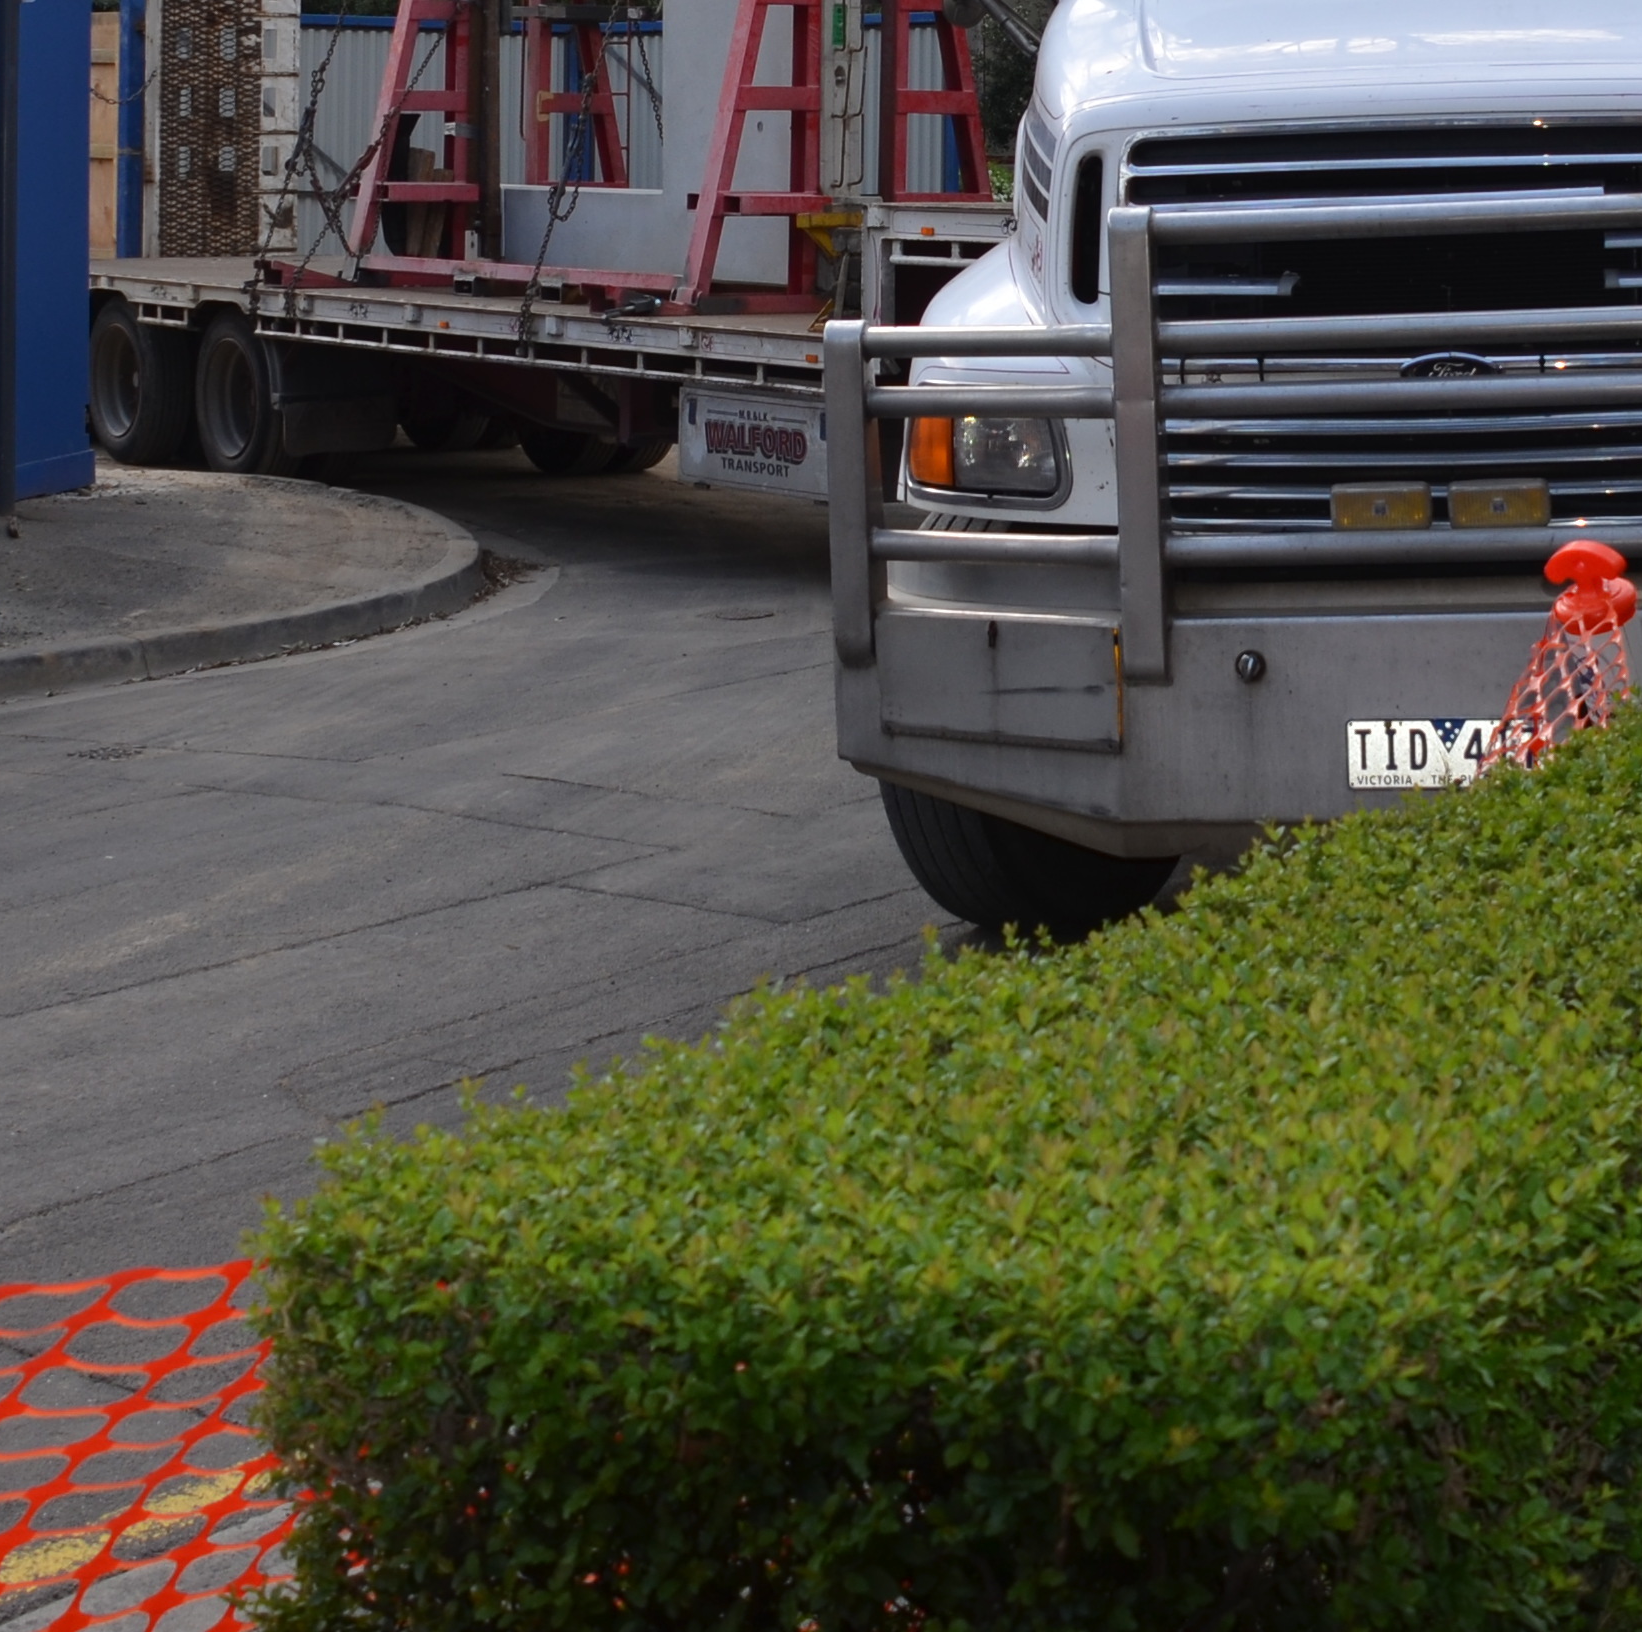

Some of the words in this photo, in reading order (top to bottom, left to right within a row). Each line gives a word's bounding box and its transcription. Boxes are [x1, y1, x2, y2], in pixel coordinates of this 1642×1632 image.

[1429, 362, 1476, 377] Ford
[705, 419, 807, 465] WALFORD
[721, 457, 790, 478] TRANSPORT
[1355, 728, 1428, 770] TID
[1357, 775, 1412, 786] VICTORIA
